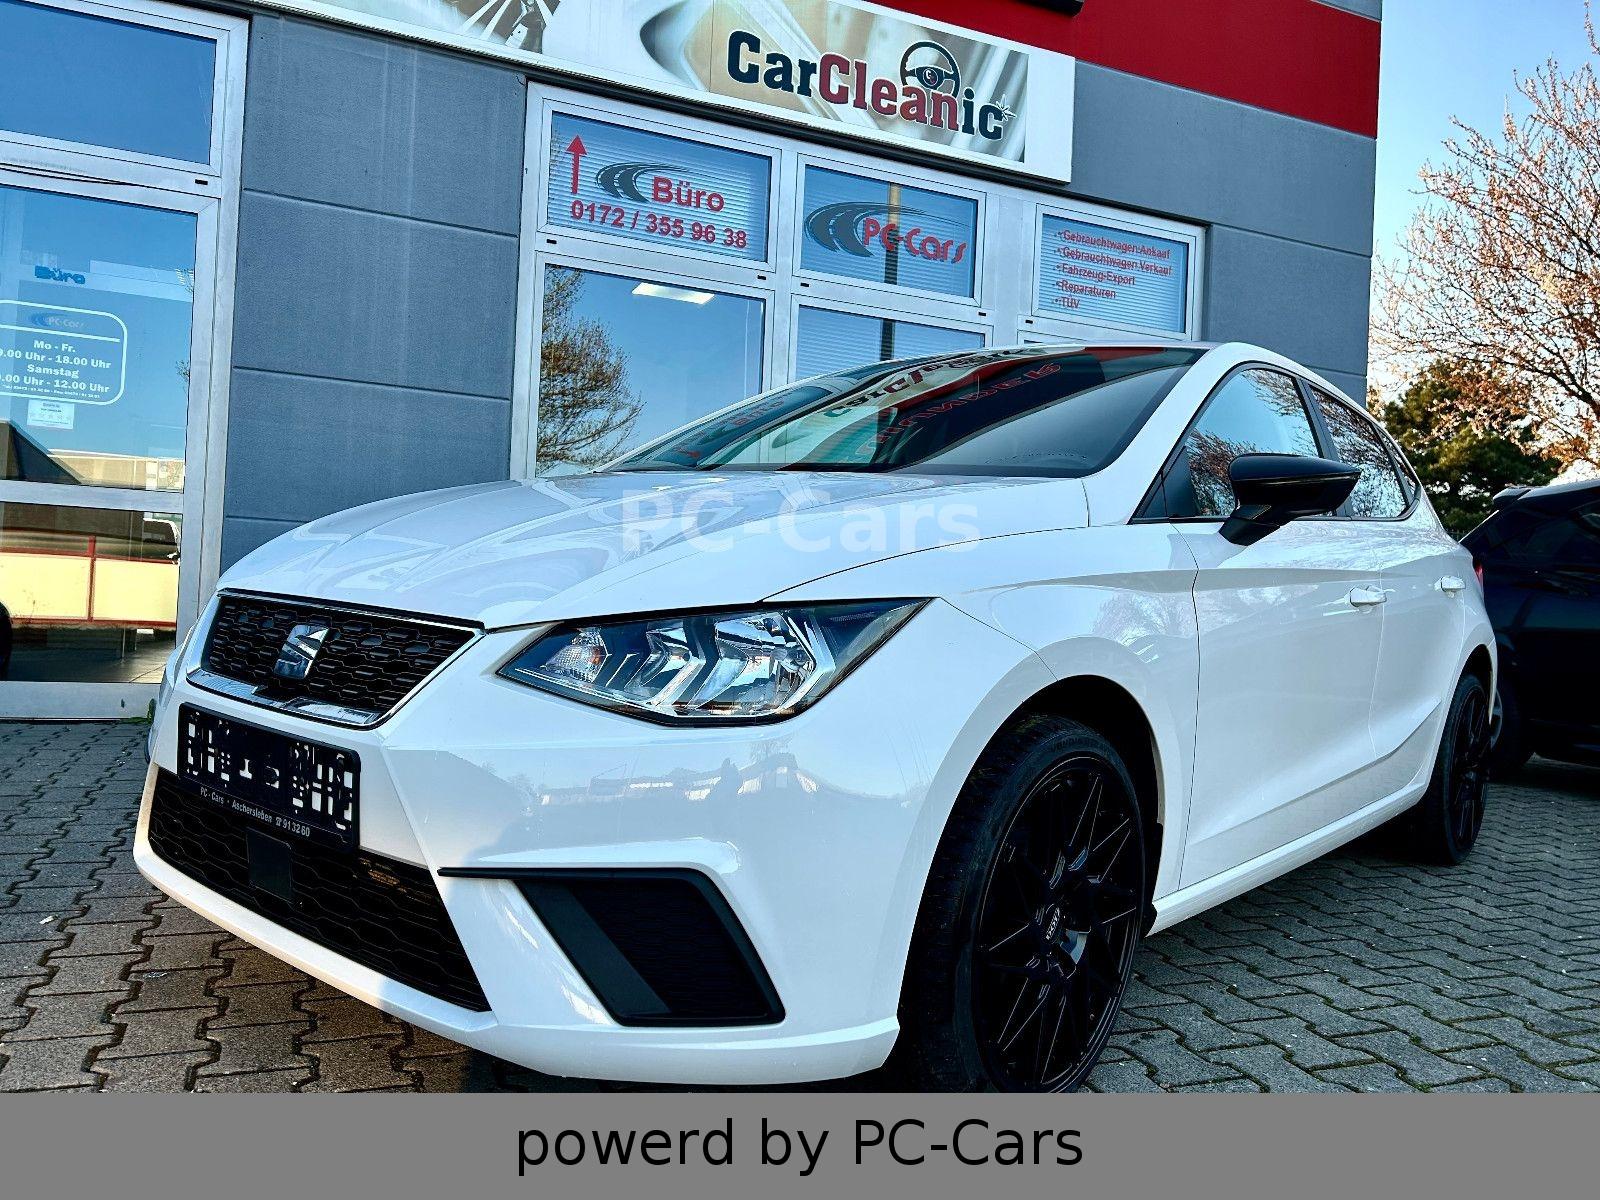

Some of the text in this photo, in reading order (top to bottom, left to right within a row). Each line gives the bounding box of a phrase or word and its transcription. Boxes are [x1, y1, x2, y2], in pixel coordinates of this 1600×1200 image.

[727, 30, 1004, 140] CarCleanic
[653, 176, 725, 212] Büro
[571, 199, 625, 229] 0172
[645, 213, 684, 238] 355
[691, 221, 716, 244] 96
[723, 227, 747, 249] 38
[862, 217, 967, 264] PC-Cars
[35, 265, 86, 285] Büro
[1061, 279, 1116, 299] Reparaturen
[33, 339, 52, 350] Mo
[25, 351, 46, 362] Uhr
[55, 355, 88, 366] 18.00
[90, 358, 112, 369] Uhr
[27, 364, 80, 379] Samstag
[23, 375, 45, 387] Uhr
[53, 379, 87, 391] 12.00
[89, 382, 110, 393] Uhr
